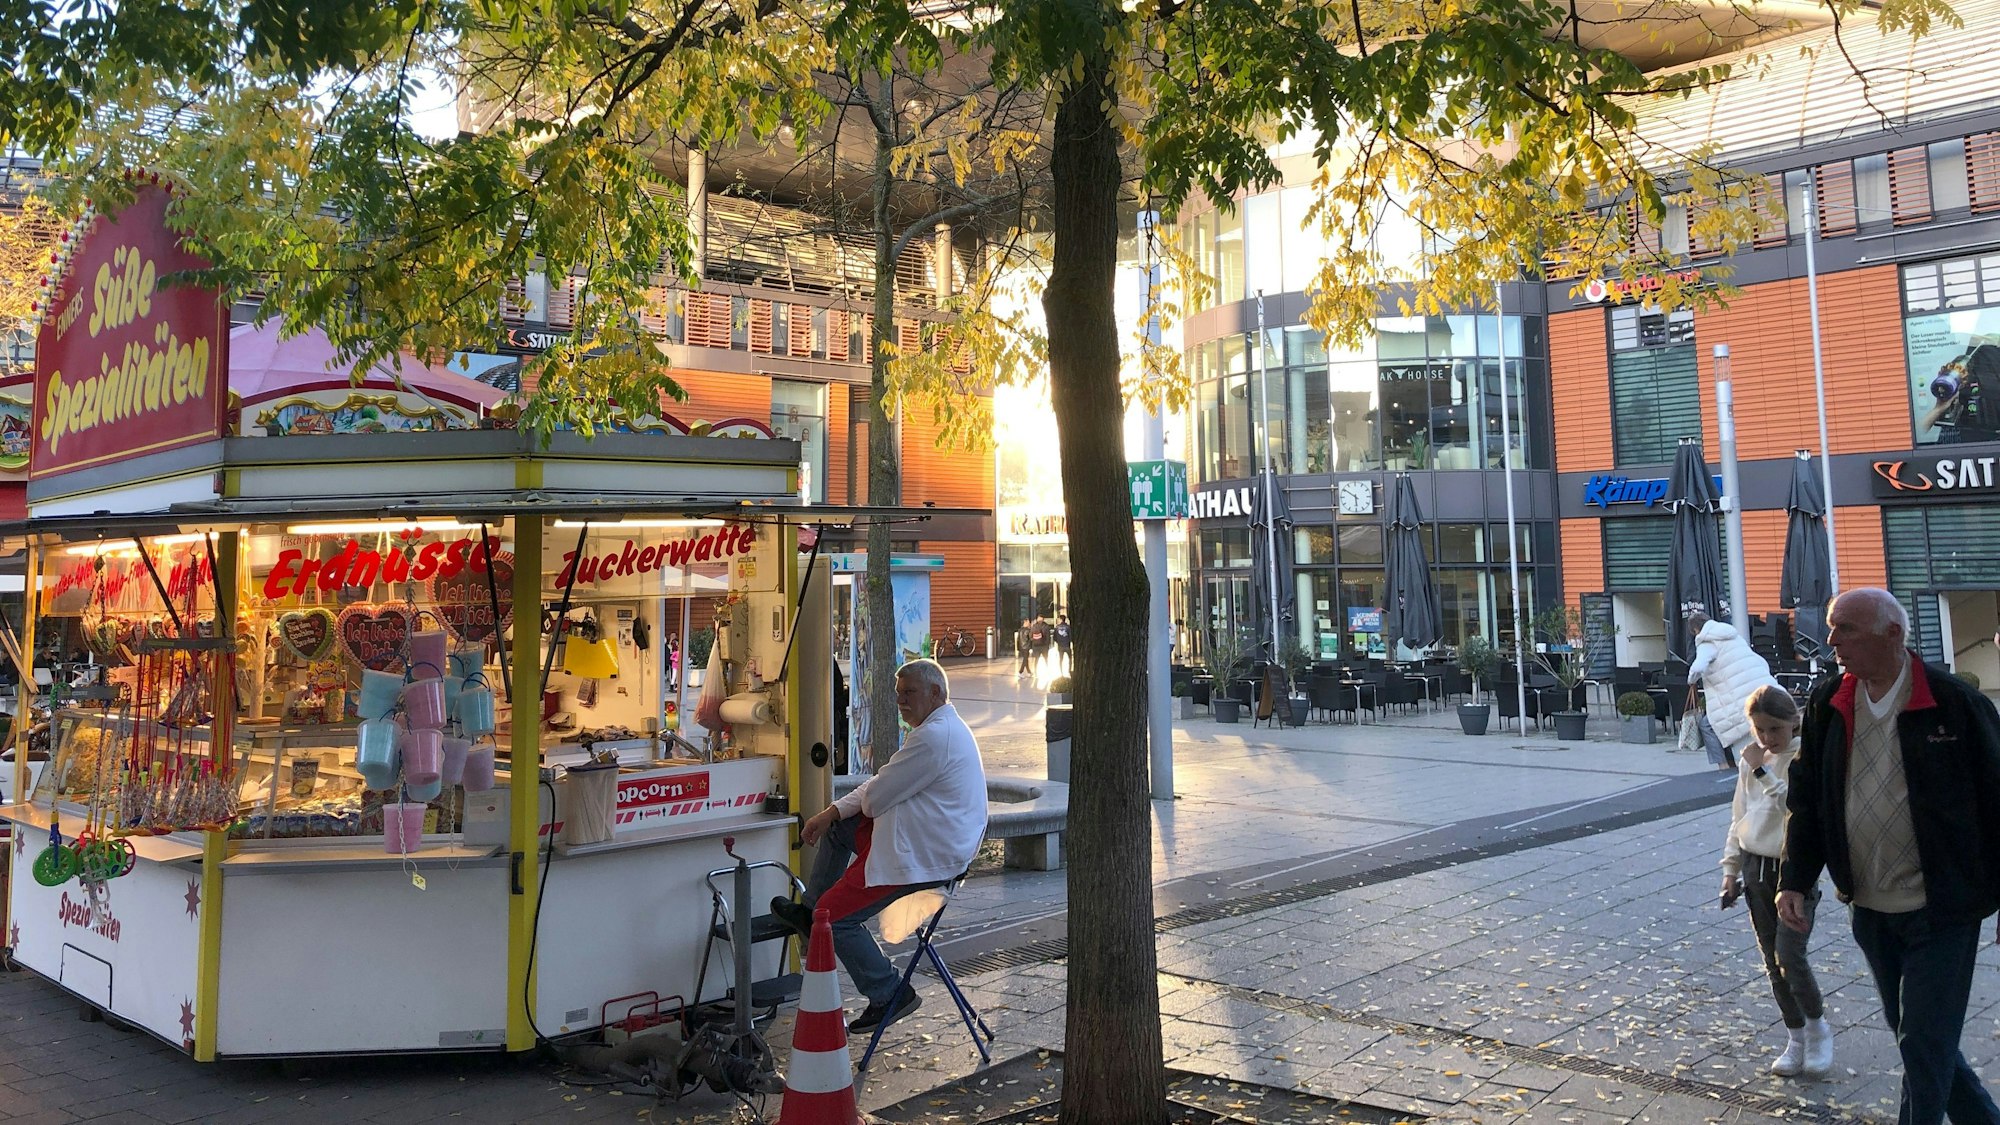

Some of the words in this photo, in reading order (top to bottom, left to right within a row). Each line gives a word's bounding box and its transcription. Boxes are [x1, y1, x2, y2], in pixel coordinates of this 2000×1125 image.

[89, 245, 157, 338] Süße
[41, 321, 210, 456] Spezialitäten
[1936, 457, 2000, 489] SAT
[1010, 512, 1068, 535] RATH
[1188, 486, 1257, 519] ATHAU
[264, 526, 501, 600] Erdnüsse
[554, 524, 756, 590] Zuckerwatte
[616, 782, 683, 803] opcorn
[58, 890, 121, 943] Speziaäten
